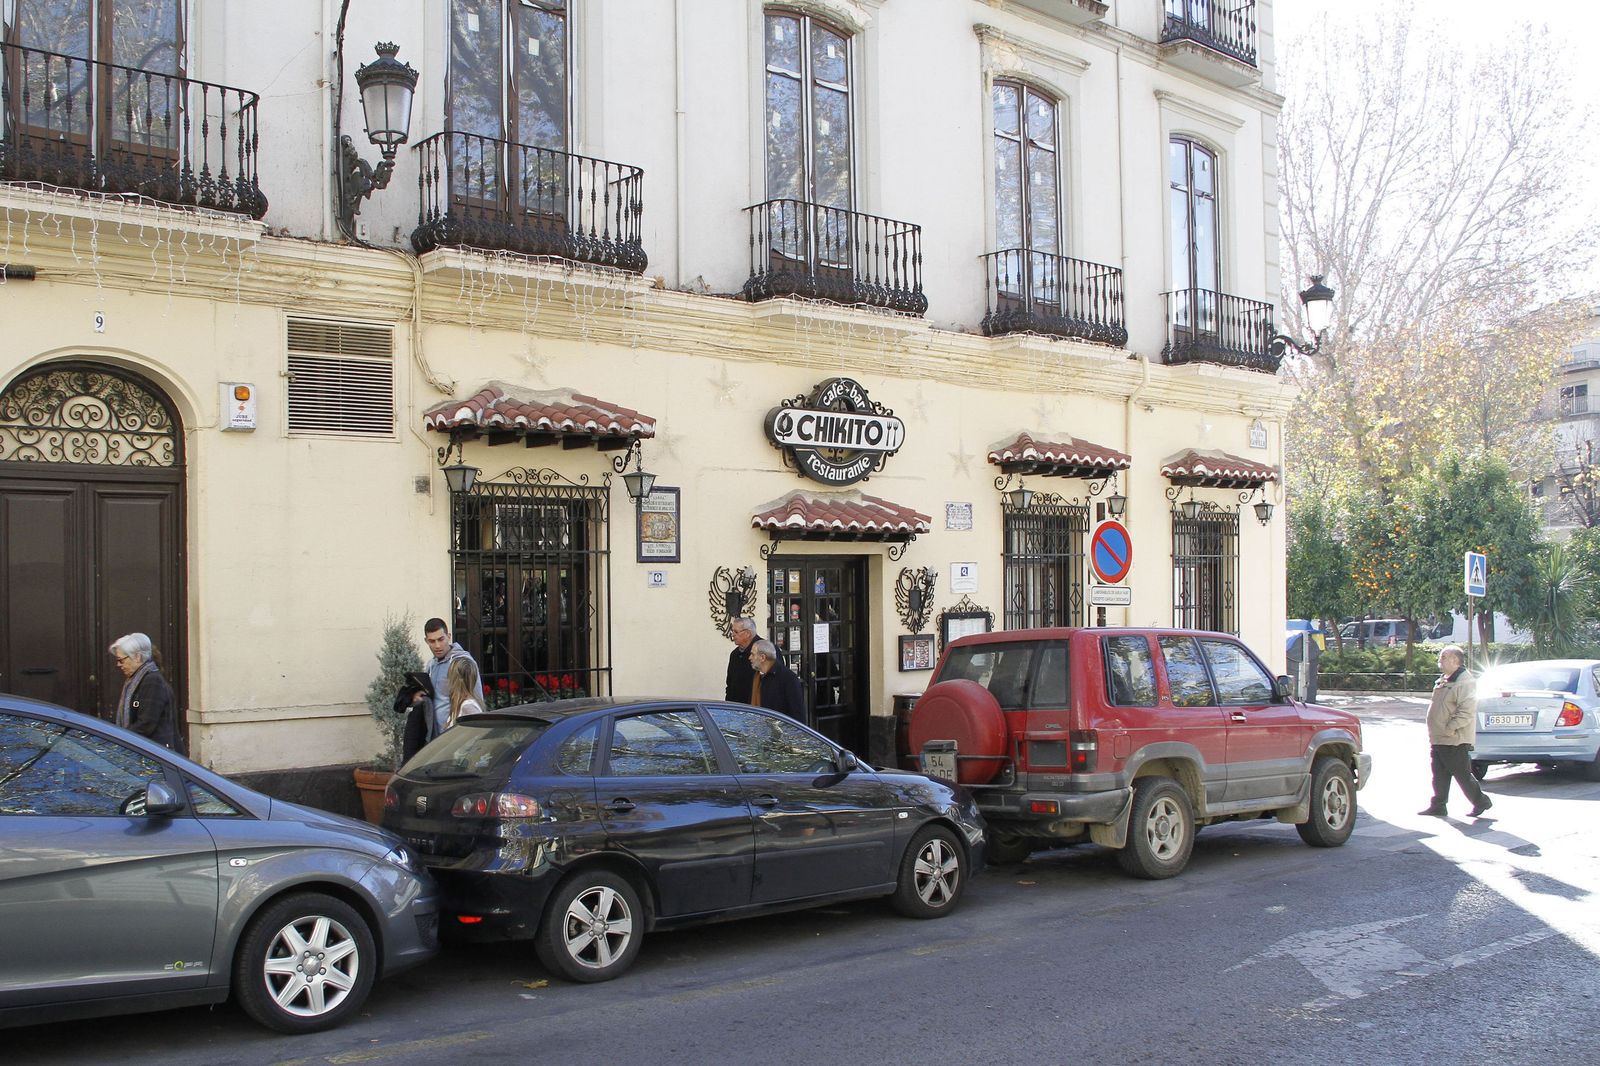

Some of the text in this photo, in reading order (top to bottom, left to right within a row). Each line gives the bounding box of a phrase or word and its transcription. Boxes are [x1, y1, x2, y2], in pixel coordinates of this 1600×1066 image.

[95, 315, 104, 329] 9
[797, 414, 884, 446] CHIKITO
[806, 453, 870, 481] restaurante
[1490, 715, 1531, 724] 6630 DTY
[930, 755, 944, 767] 54
